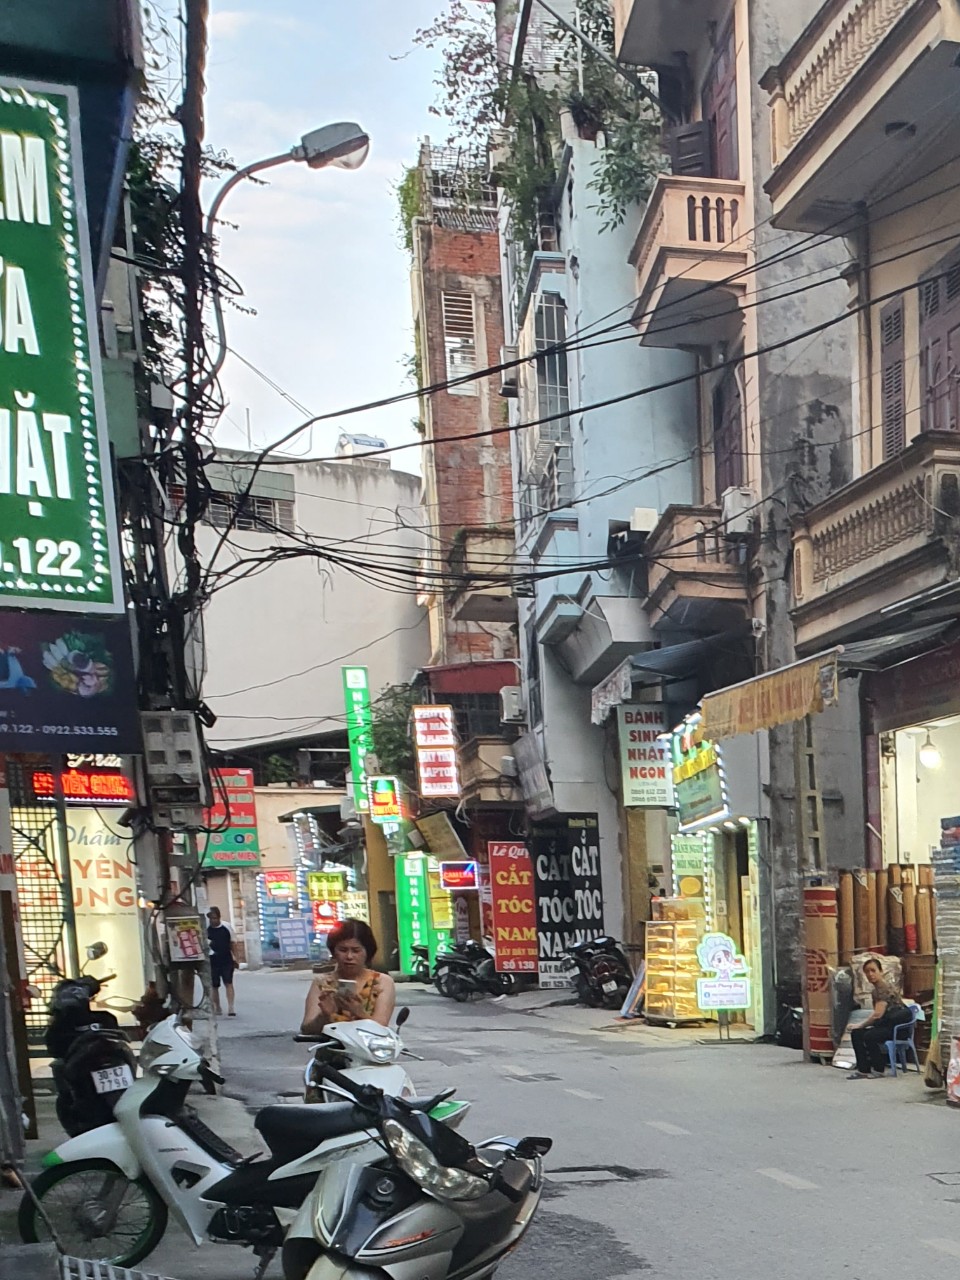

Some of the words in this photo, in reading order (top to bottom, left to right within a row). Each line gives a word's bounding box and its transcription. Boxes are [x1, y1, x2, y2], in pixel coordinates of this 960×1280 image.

[0, 132, 51, 225] M
[627, 746, 665, 763] NHẬT
[629, 766, 666, 779] NGON
[492, 845, 508, 856] Lê
[571, 829, 599, 877] CẮT
[495, 864, 532, 885] CẮT
[497, 895, 533, 914] TÓC
[538, 889, 574, 923] TÓC
[574, 880, 602, 920] TÓC
[496, 927, 538, 942] NAM
[502, 957, 516, 970] SỐ
